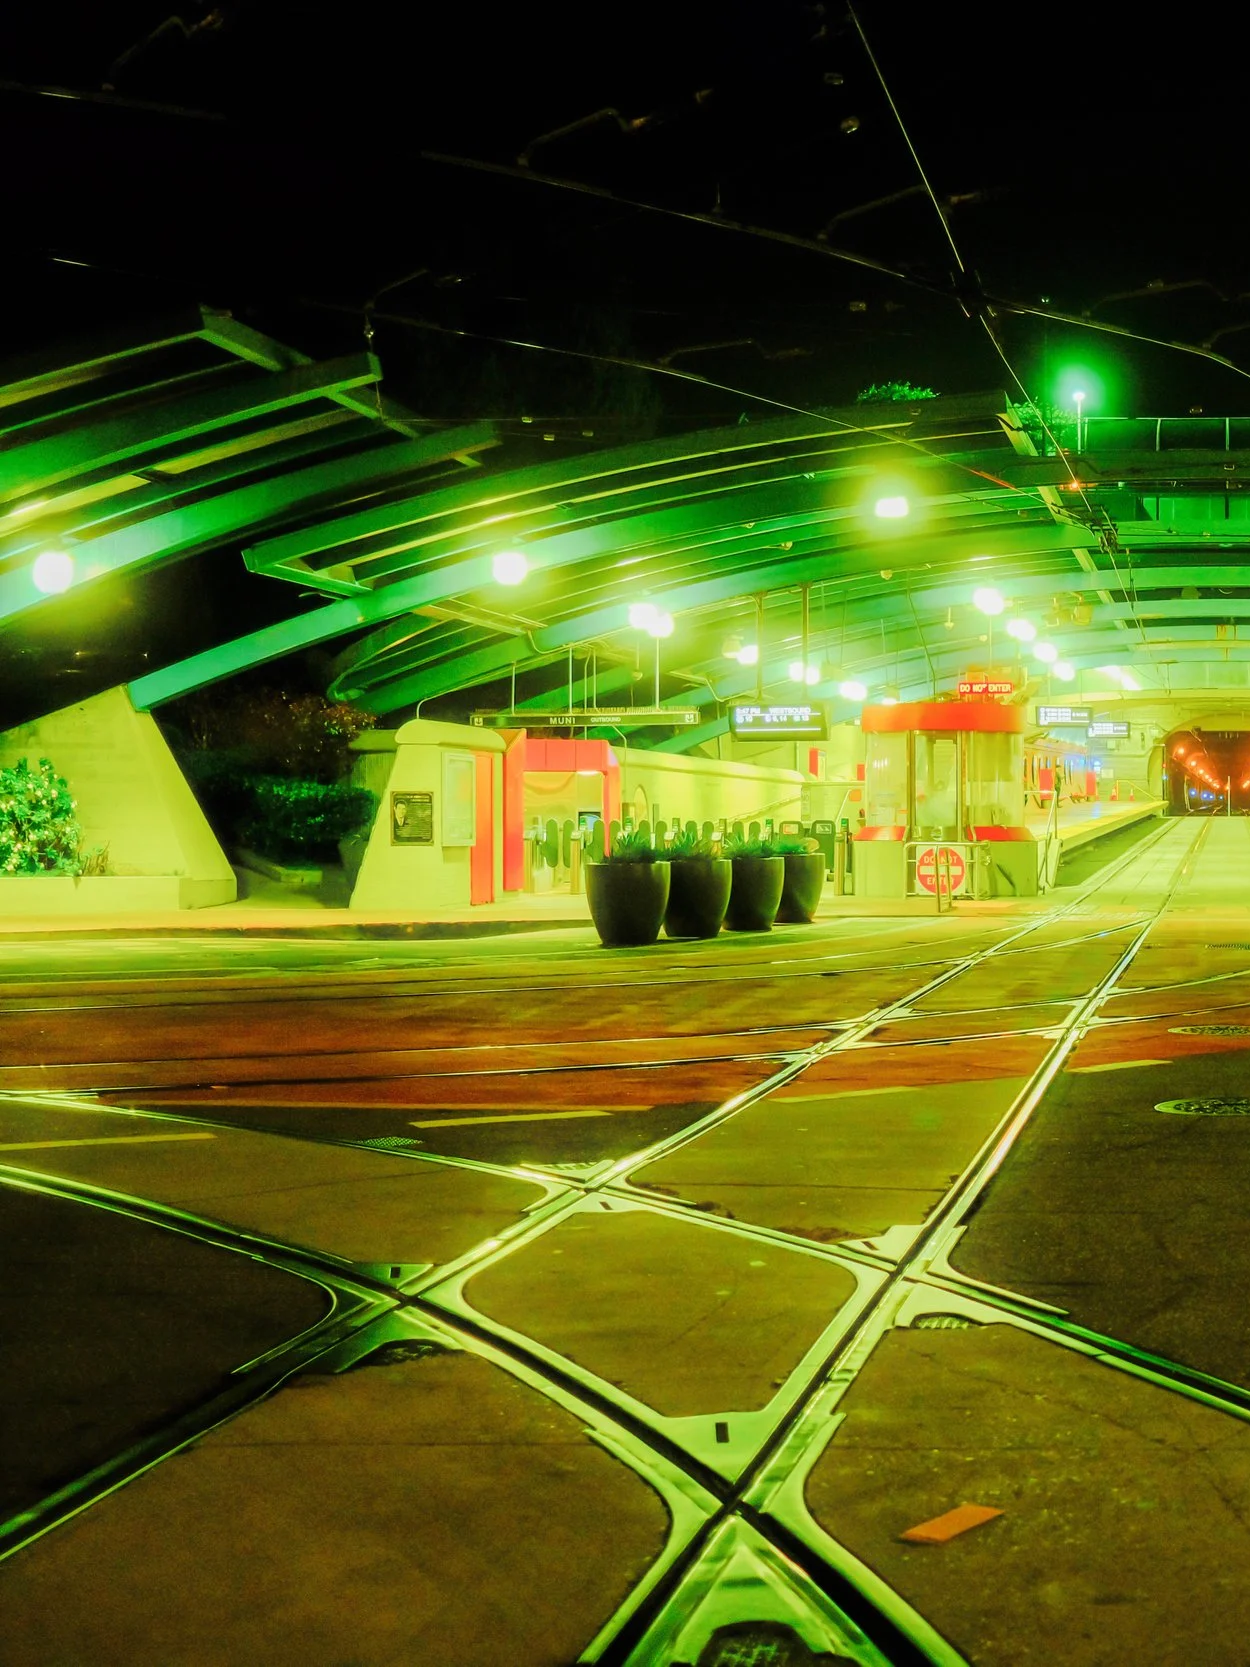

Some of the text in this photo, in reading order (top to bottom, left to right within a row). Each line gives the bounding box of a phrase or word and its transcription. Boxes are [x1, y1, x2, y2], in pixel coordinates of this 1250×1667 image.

[960, 684, 1011, 692] DO NOT ENTER
[549, 717, 576, 725] MUNI
